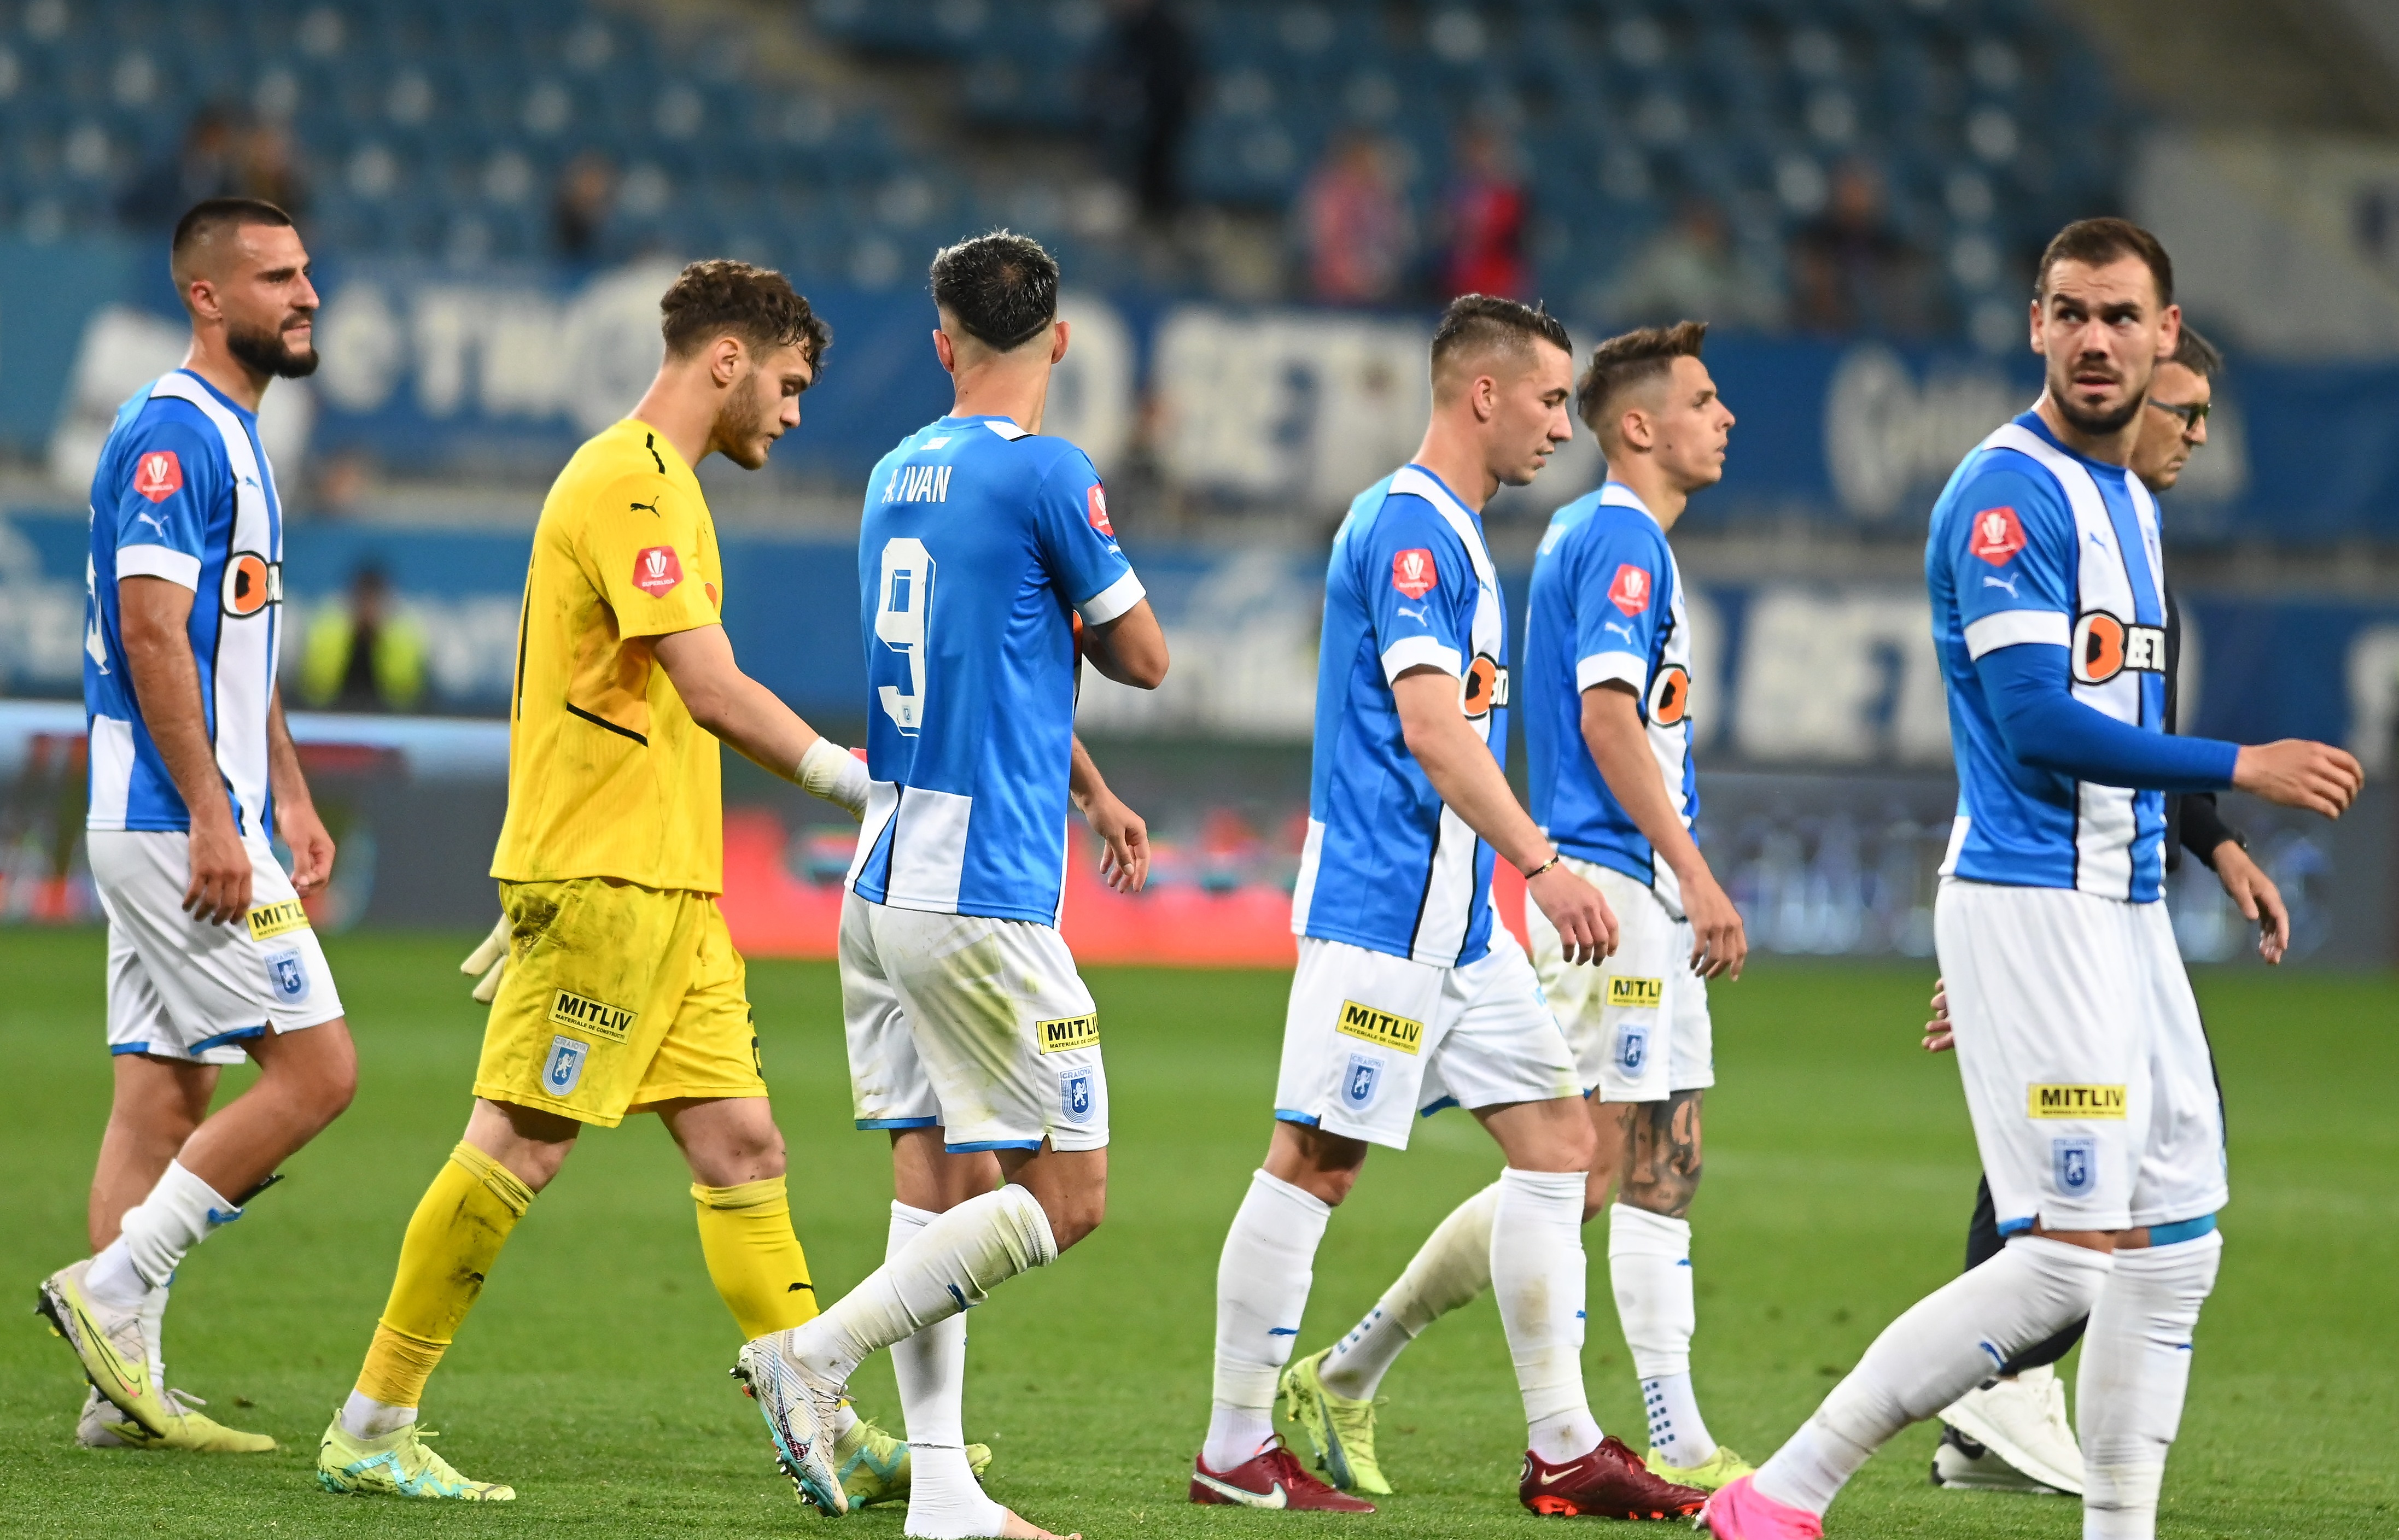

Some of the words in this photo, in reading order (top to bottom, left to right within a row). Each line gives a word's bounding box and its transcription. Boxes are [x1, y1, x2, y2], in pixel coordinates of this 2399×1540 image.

[875, 537, 937, 737] 9
[557, 993, 632, 1032] MITLIV
[556, 1014, 587, 1028] MATERIALE
[1346, 1005, 1420, 1043] MITLIV
[1344, 1025, 1378, 1040] MATERIALE
[554, 1037, 587, 1052] CRAIOVA
[1049, 1040, 1079, 1049] MATERIALE
[1062, 1068, 1091, 1079] CRAIOVA
[2042, 1088, 2124, 1106] MITLIV
